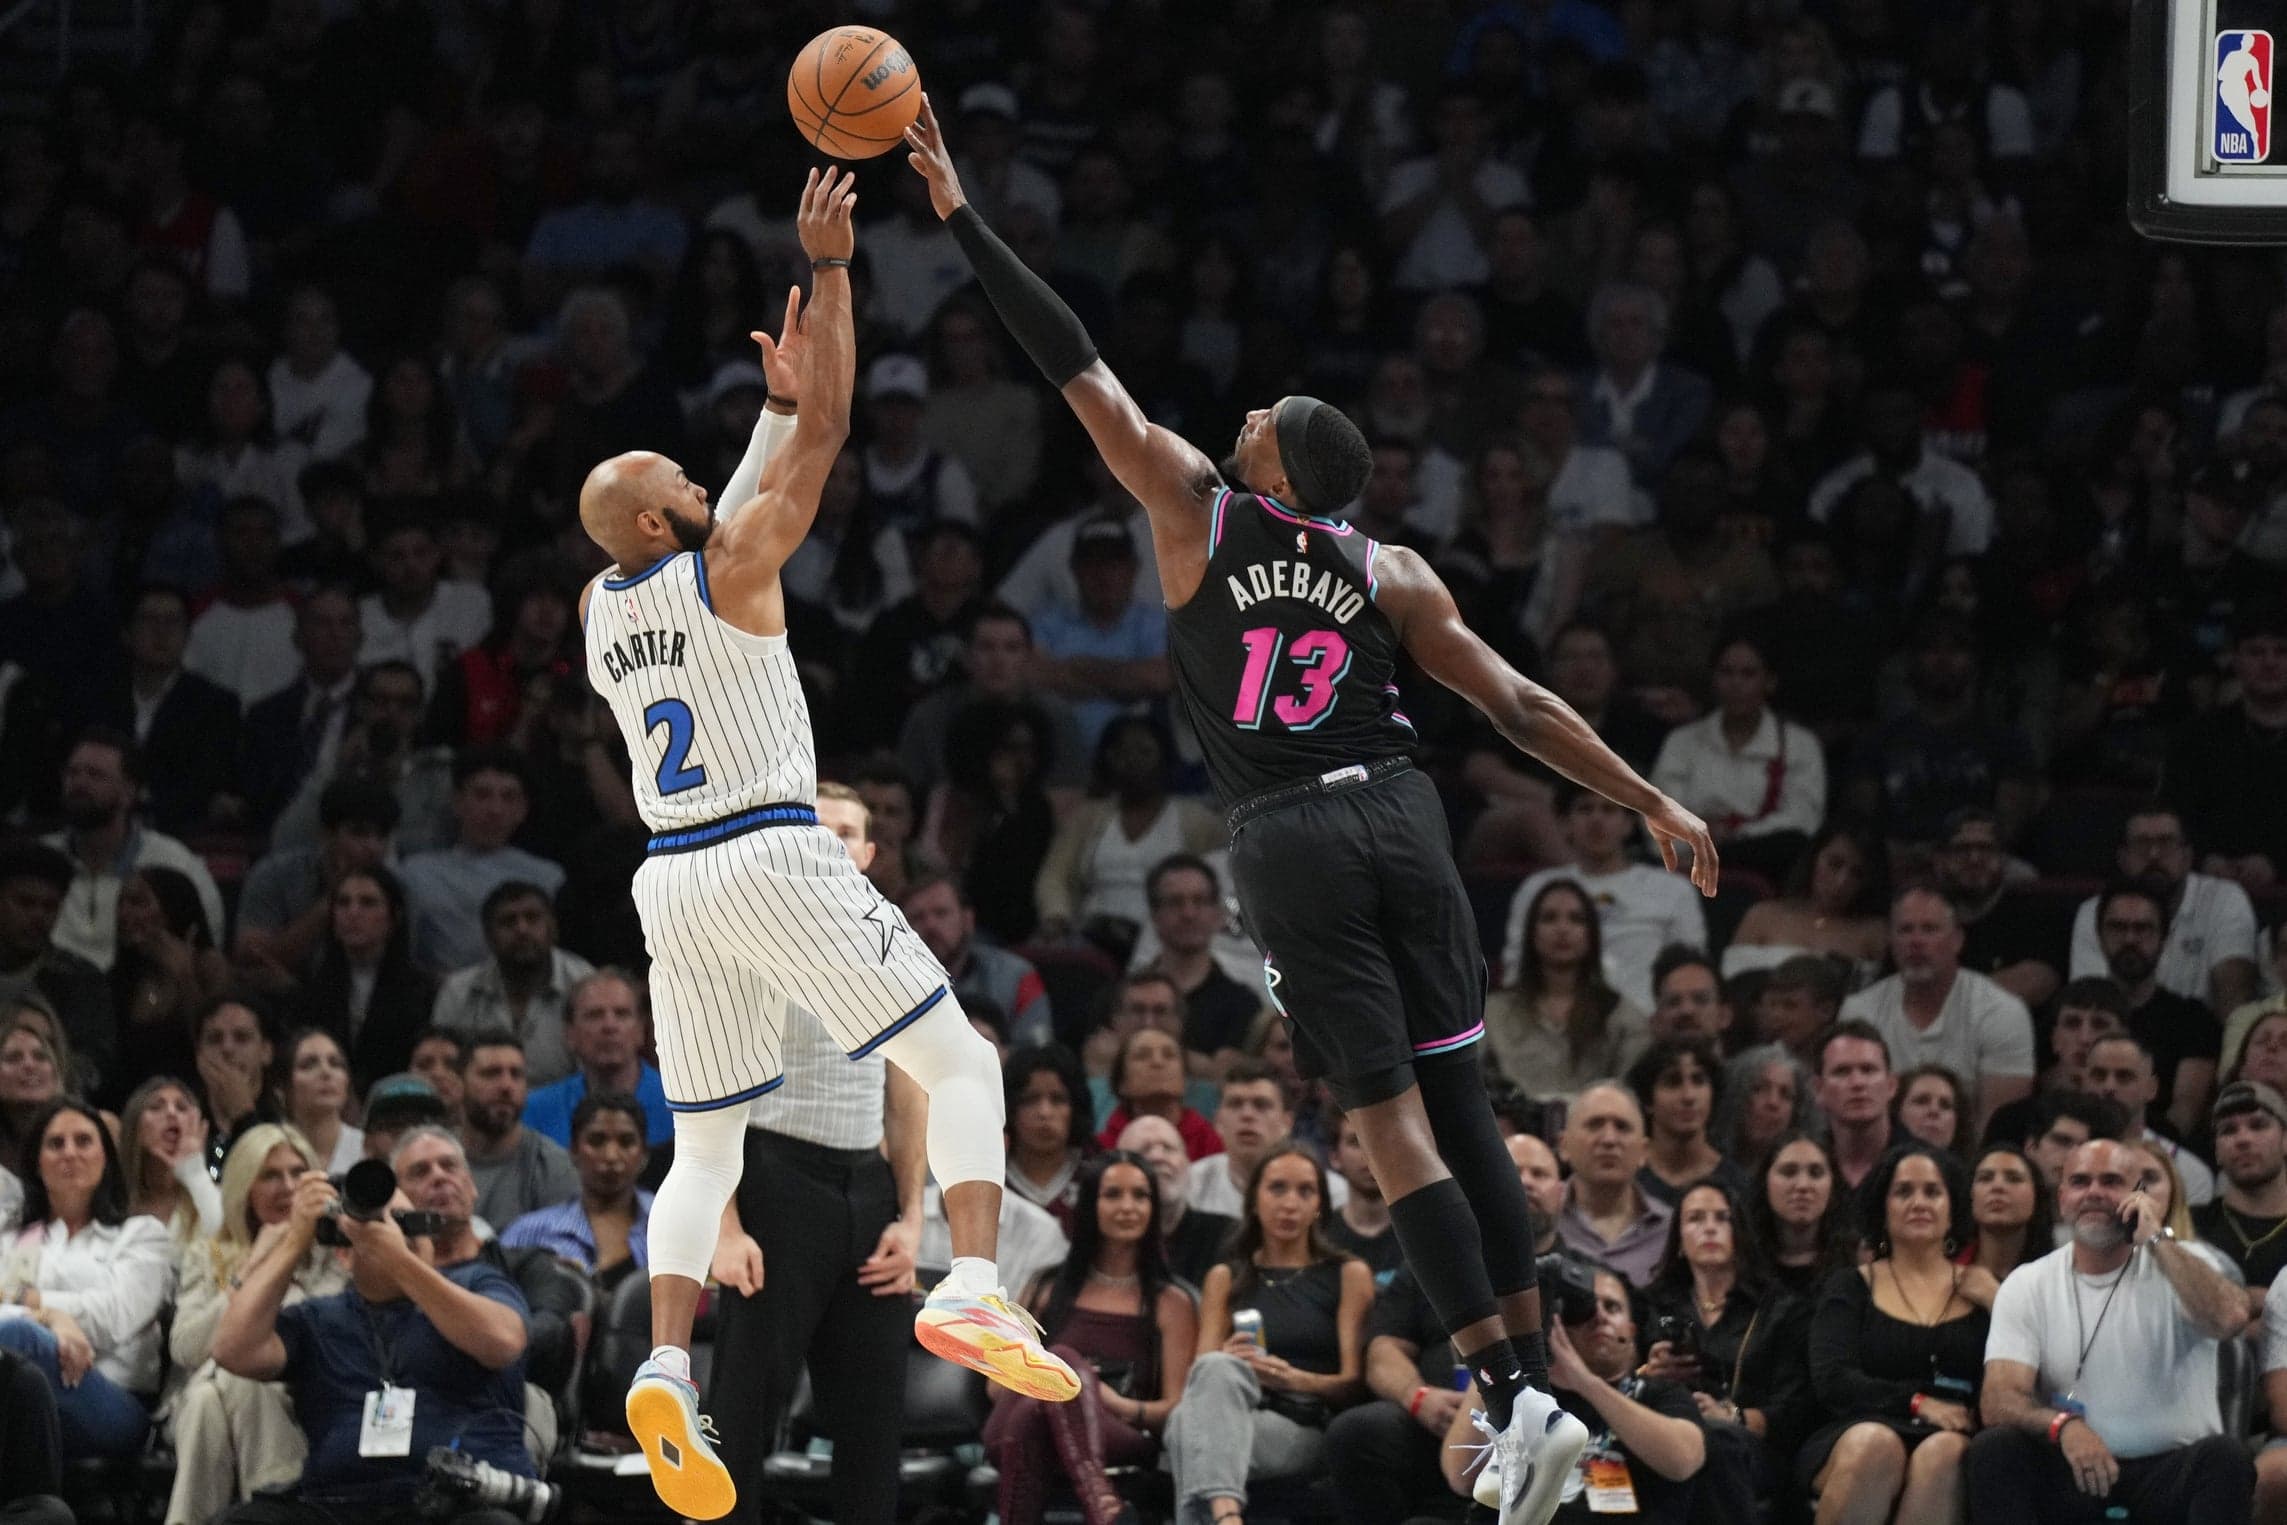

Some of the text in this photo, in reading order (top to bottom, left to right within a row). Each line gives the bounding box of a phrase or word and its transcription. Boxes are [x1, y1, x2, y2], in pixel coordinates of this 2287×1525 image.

[2220, 132, 2248, 154] NBA
[1227, 560, 1365, 624] ADEBAYO
[603, 629, 686, 684] CARTER
[1233, 626, 1352, 731] 13
[643, 697, 707, 797] 2
